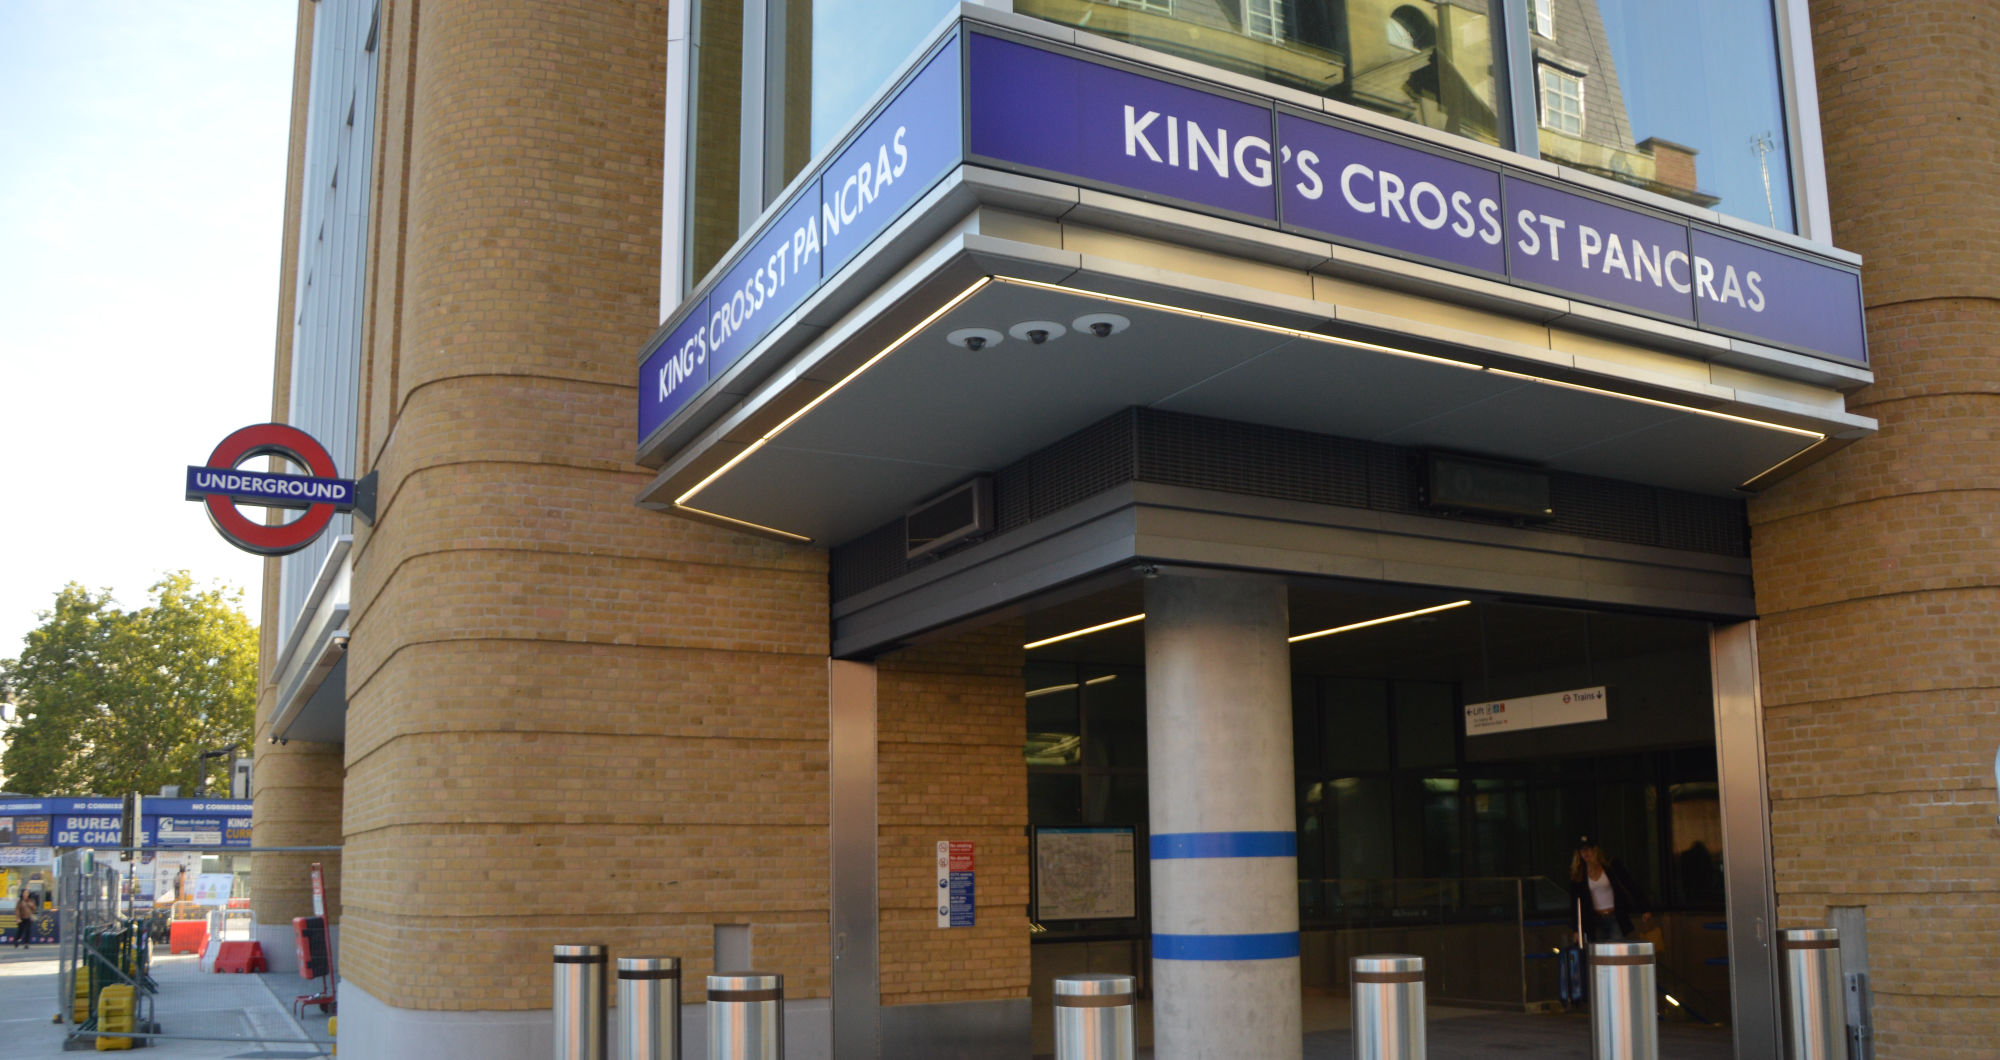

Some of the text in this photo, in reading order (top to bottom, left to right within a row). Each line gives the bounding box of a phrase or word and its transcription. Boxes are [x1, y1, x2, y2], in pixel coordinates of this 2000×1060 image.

[1124, 104, 1765, 313] KING'S CROSS ST PANCRAS
[659, 126, 908, 402] KING'S CROSS ST PANCRAS
[196, 472, 346, 499] UNDERGROUND
[1573, 692, 1595, 702] Trains
[67, 817, 120, 830] BUREA
[58, 831, 150, 843] DE CHAE
[226, 828, 252, 839] CURR
